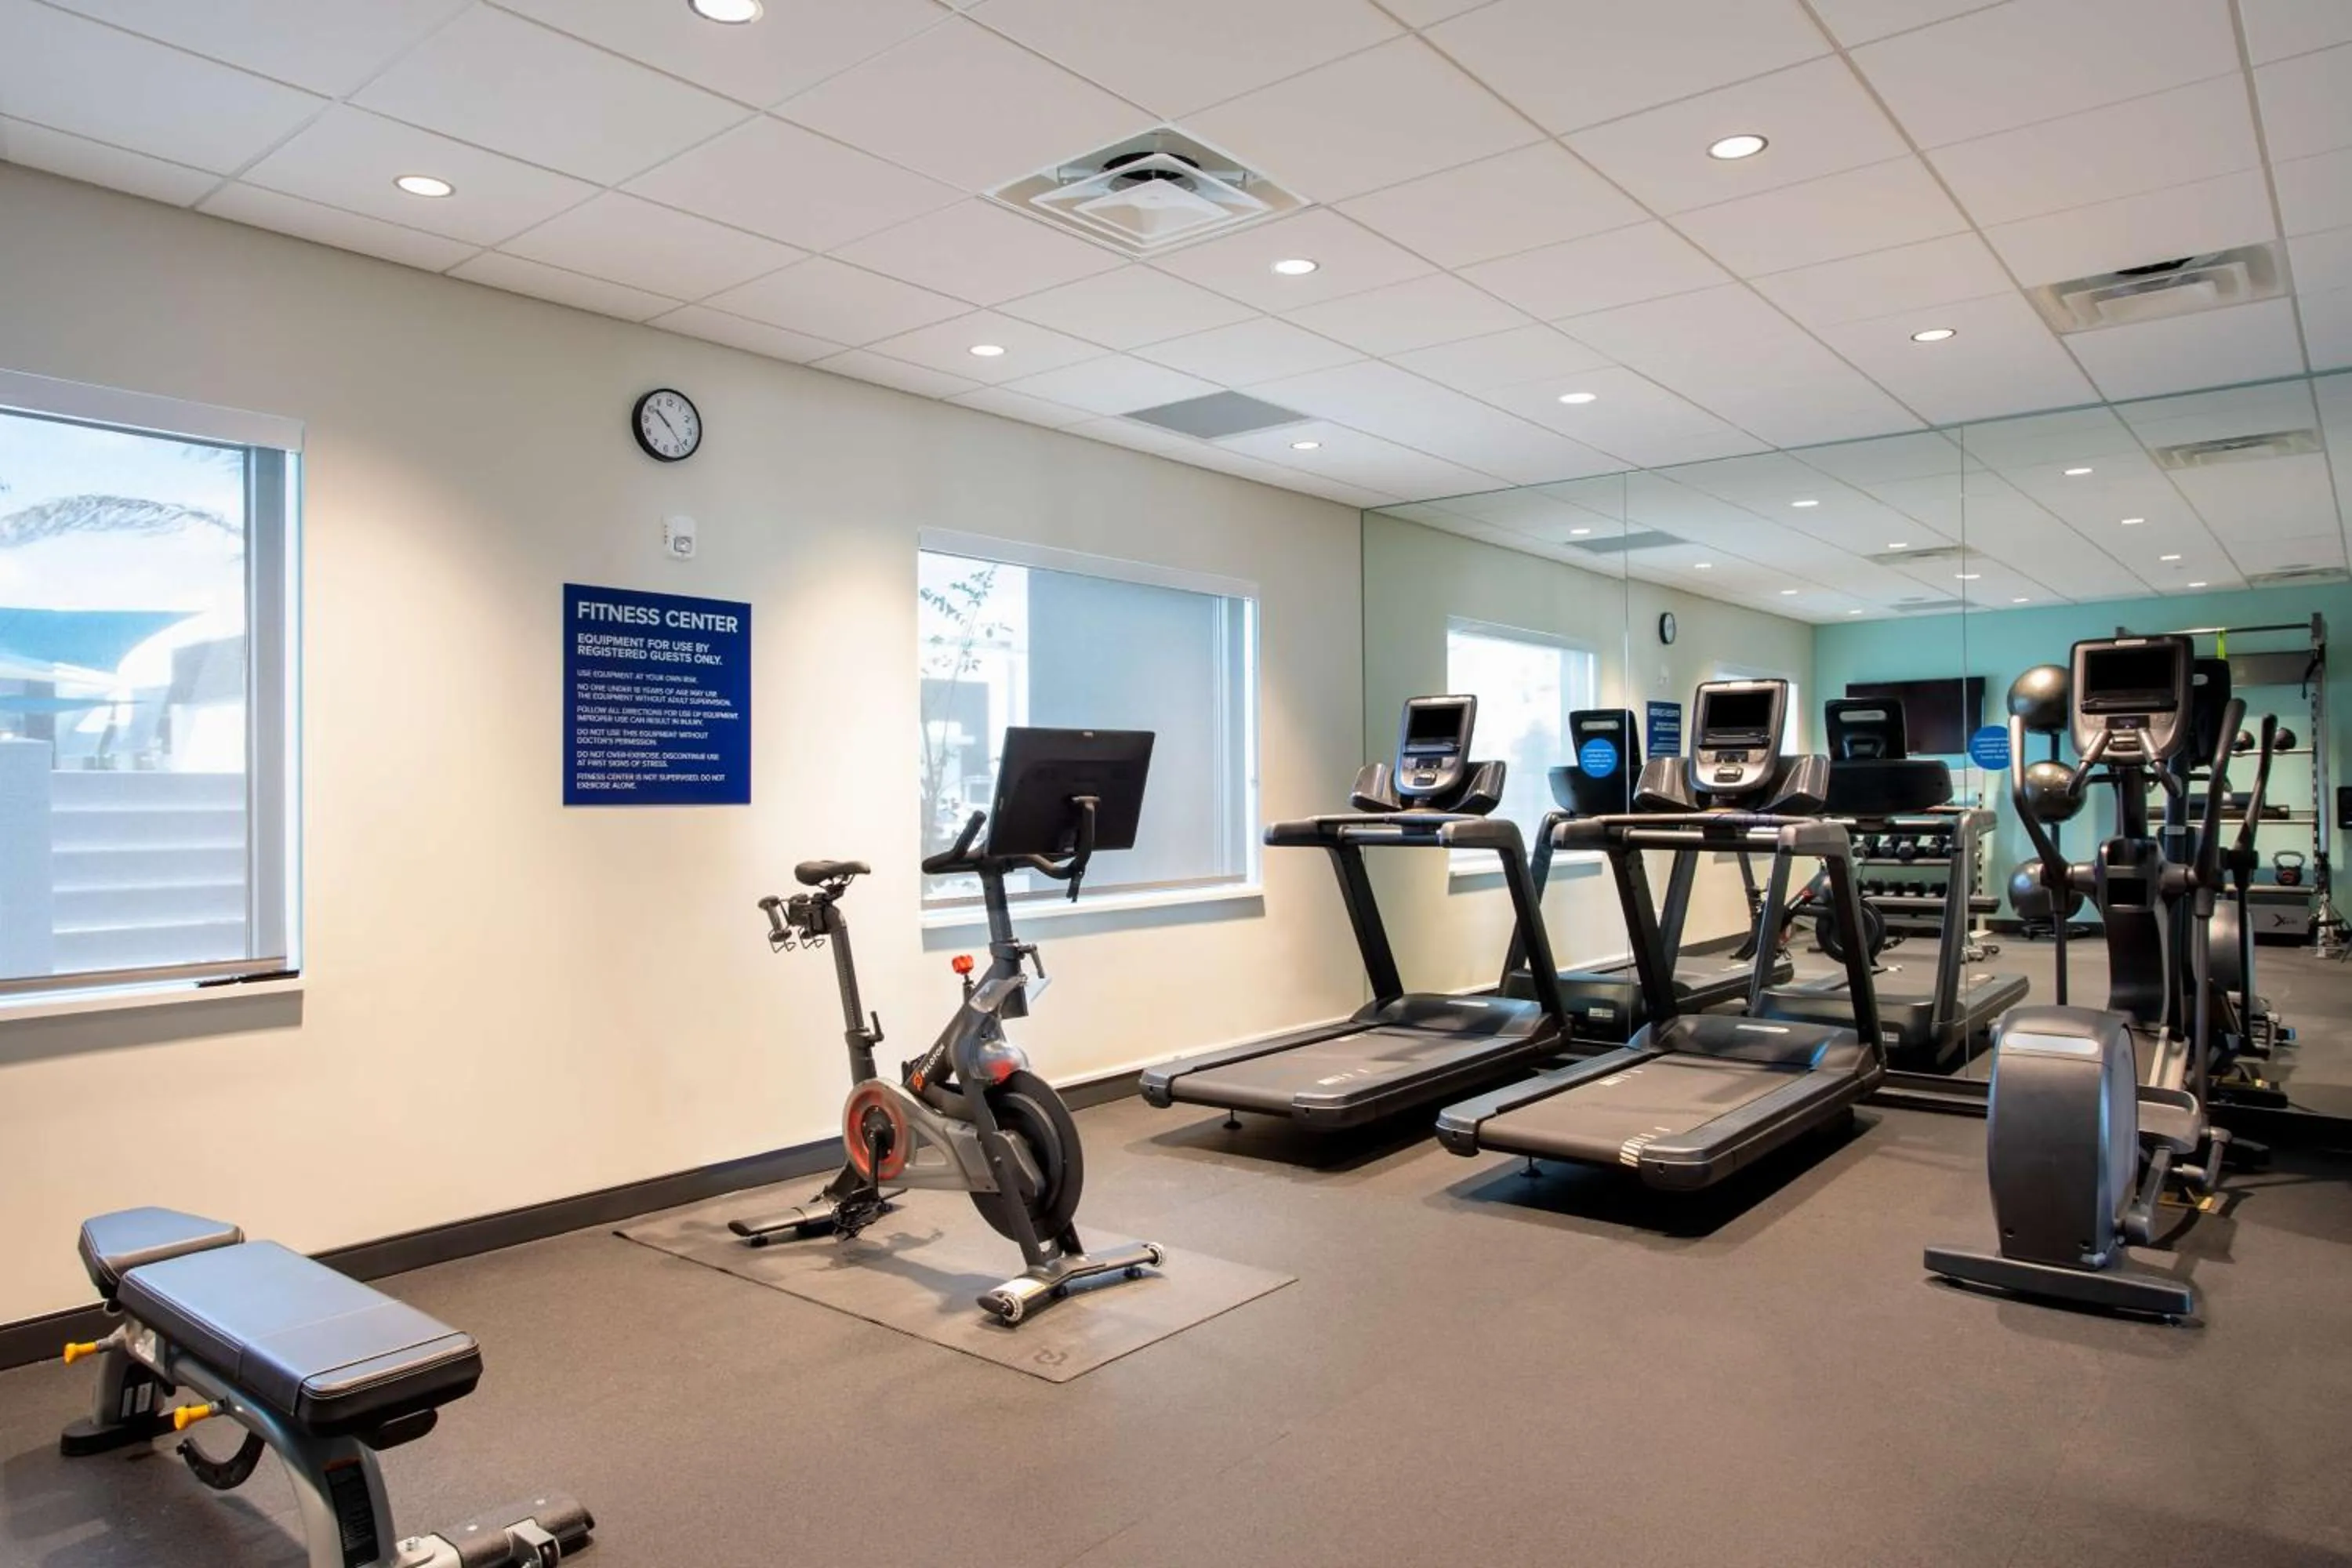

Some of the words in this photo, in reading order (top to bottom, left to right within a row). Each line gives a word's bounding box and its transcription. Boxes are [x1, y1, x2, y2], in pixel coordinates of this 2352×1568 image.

[578, 601, 660, 626] FITNESS
[666, 610, 739, 633] CENTER
[578, 633, 644, 648] EQUIPMENT
[648, 638, 670, 650] FOR
[672, 641, 694, 652] USE
[695, 643, 710, 653] BY
[578, 645, 647, 659] REGISTERED
[650, 650, 691, 663] GUESTS
[694, 653, 723, 666] ONLY.
[593, 670, 633, 680] EQUIPMENT
[607, 684, 632, 693] UNDER
[577, 691, 590, 699] THE
[593, 692, 633, 702] EQUIPMENT
[635, 695, 666, 703] WITHOUT
[577, 705, 606, 713] FOLLOW
[921, 1042, 946, 1077] PELOTON
